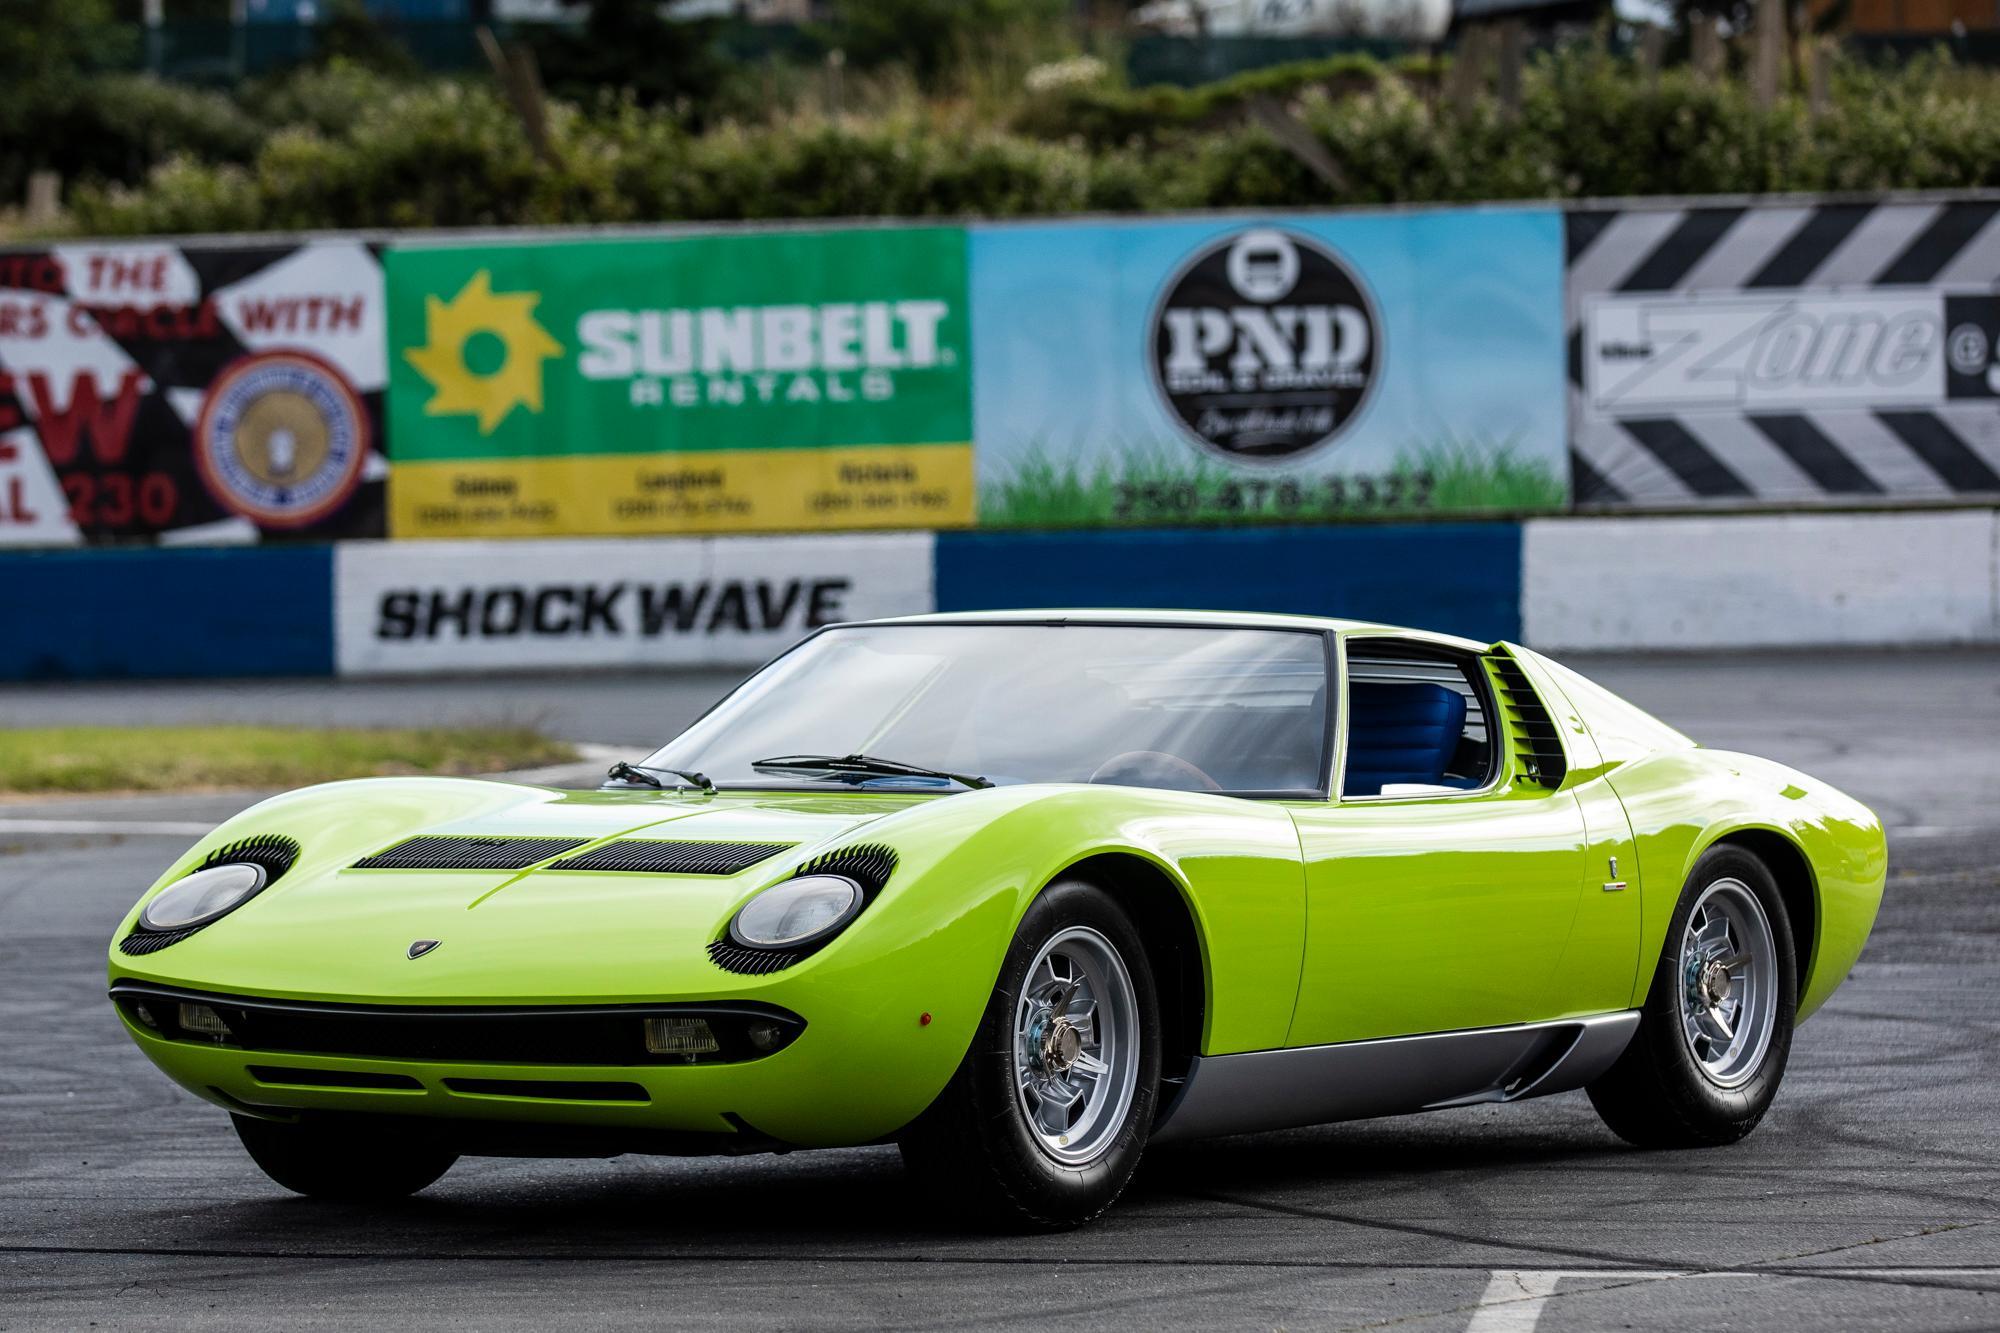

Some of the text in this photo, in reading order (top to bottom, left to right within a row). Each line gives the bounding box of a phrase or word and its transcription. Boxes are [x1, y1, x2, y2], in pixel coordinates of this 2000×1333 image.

[88, 254, 170, 292] THE
[240, 296, 366, 333] WITH
[577, 301, 947, 379] SUNBELT
[1165, 304, 1370, 370] PND
[1598, 298, 1943, 411] Zone
[630, 373, 895, 406] RENTALS
[61, 470, 177, 528] 230
